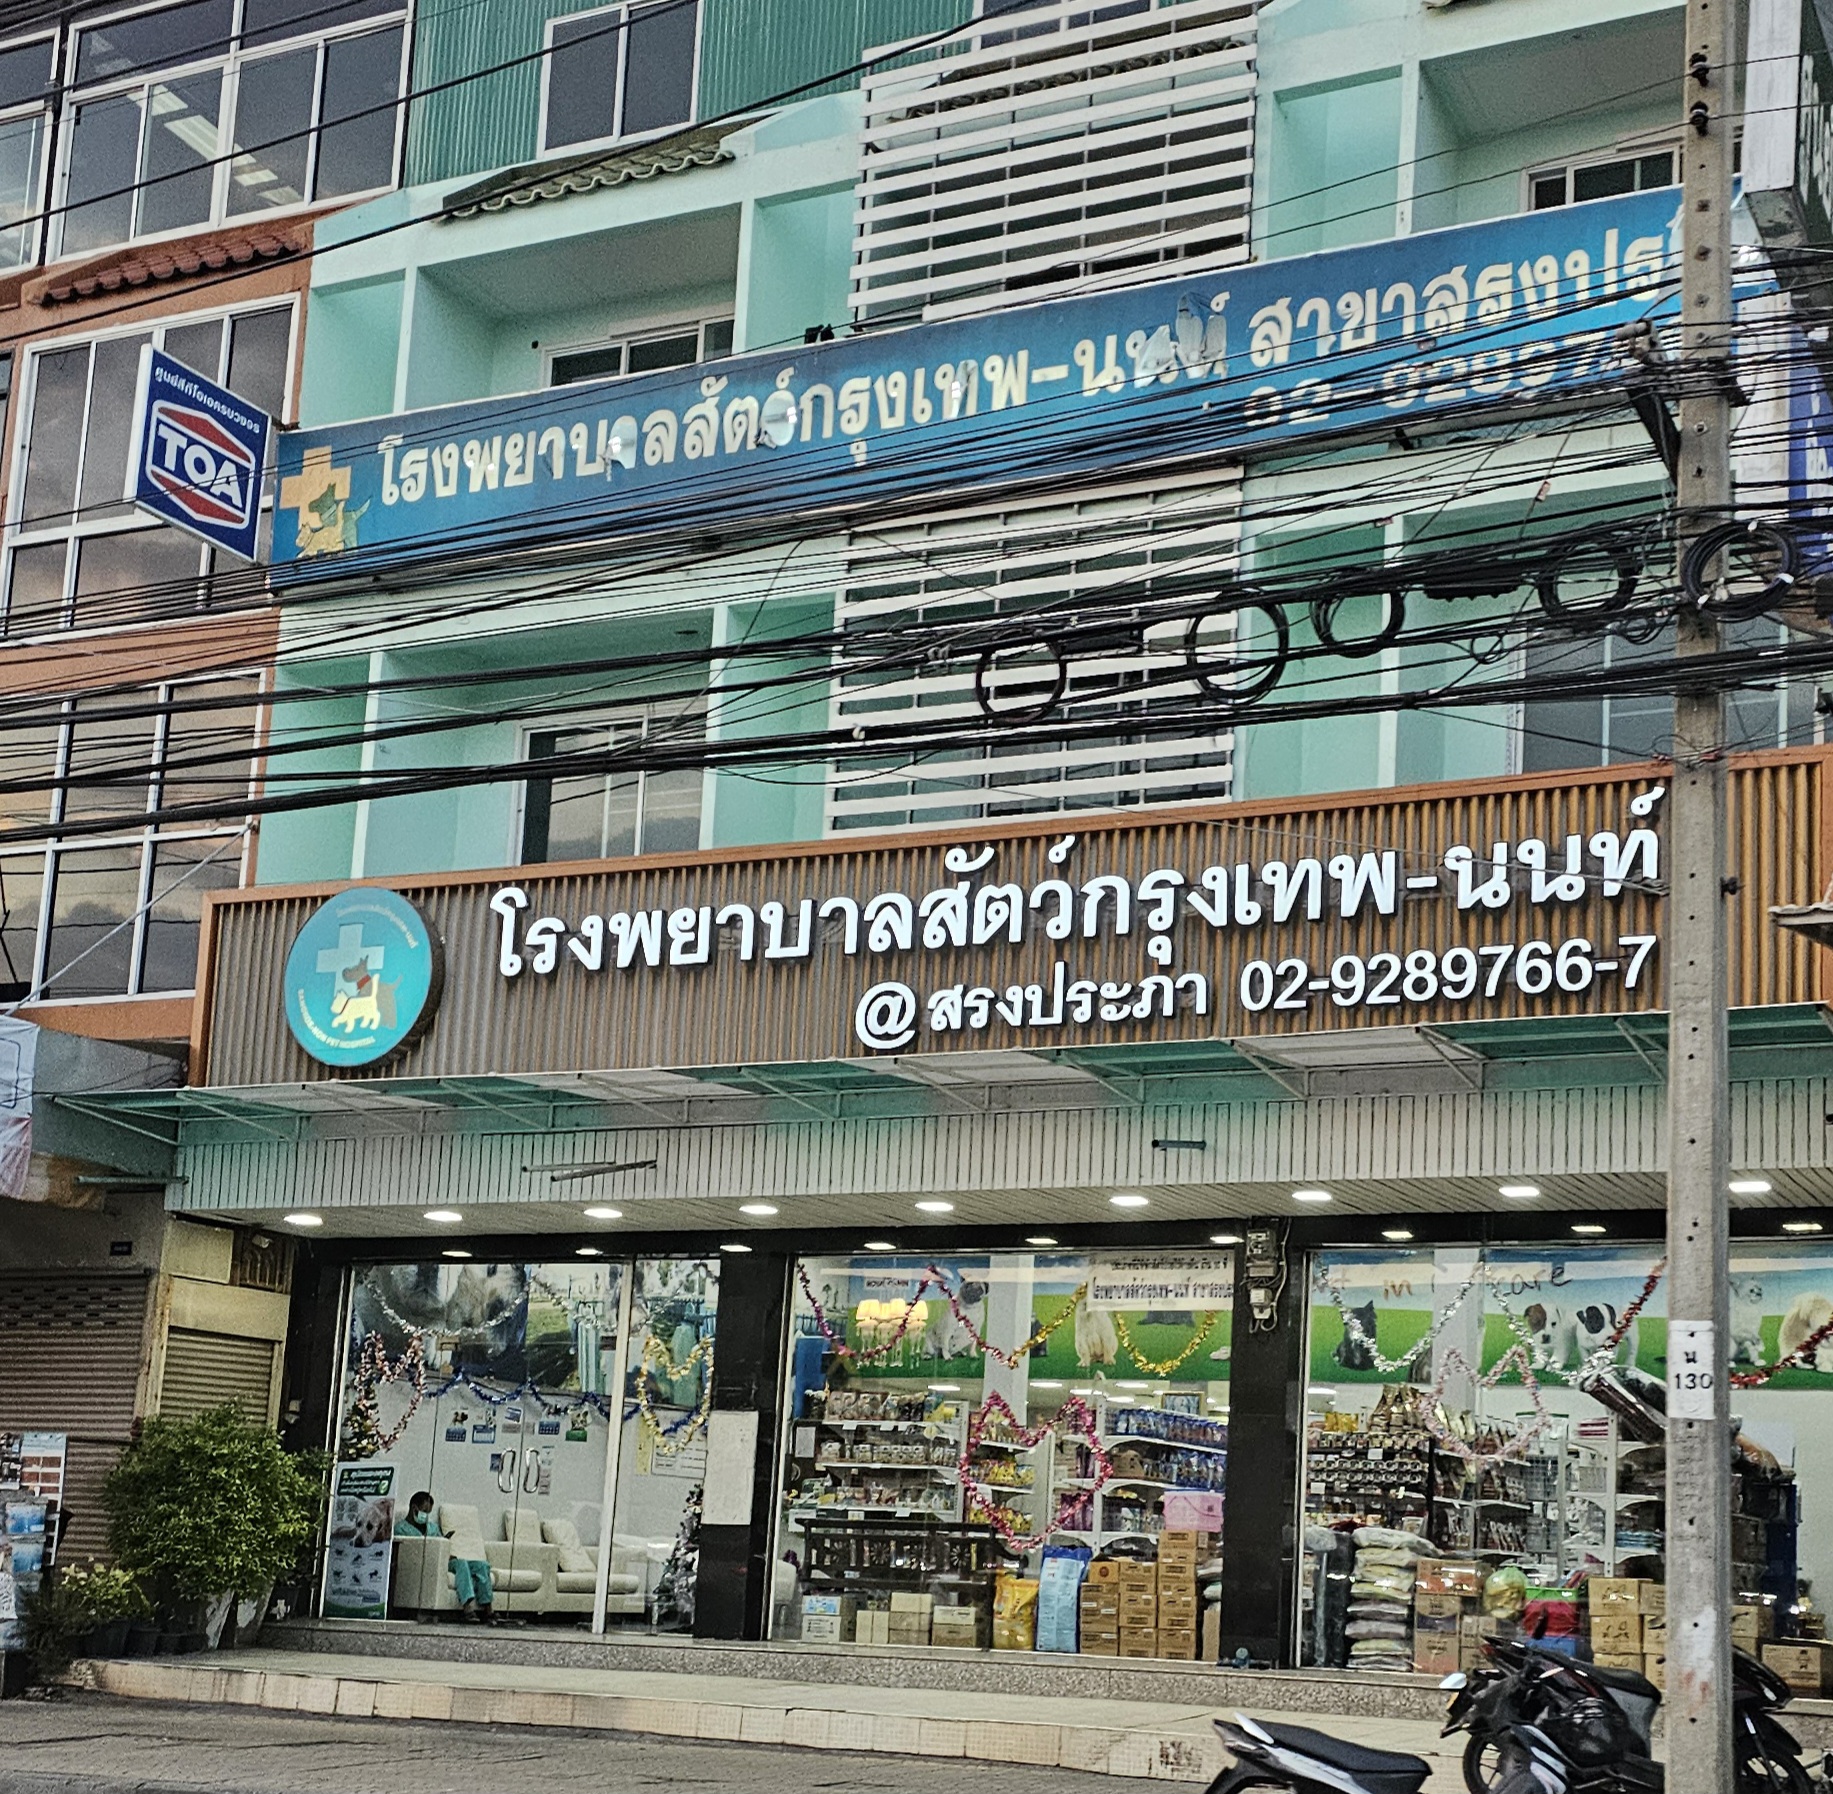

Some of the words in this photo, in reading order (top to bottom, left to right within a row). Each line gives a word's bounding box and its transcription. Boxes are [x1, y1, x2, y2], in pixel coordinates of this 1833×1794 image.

[157, 423, 243, 509] TOA
[490, 786, 1666, 977] โรงพยาบาลสัตว์กรุงเทพ-นนท์
[1240, 935, 1658, 1012] 02-9289766-7
[1675, 1372, 1714, 1390] 130
